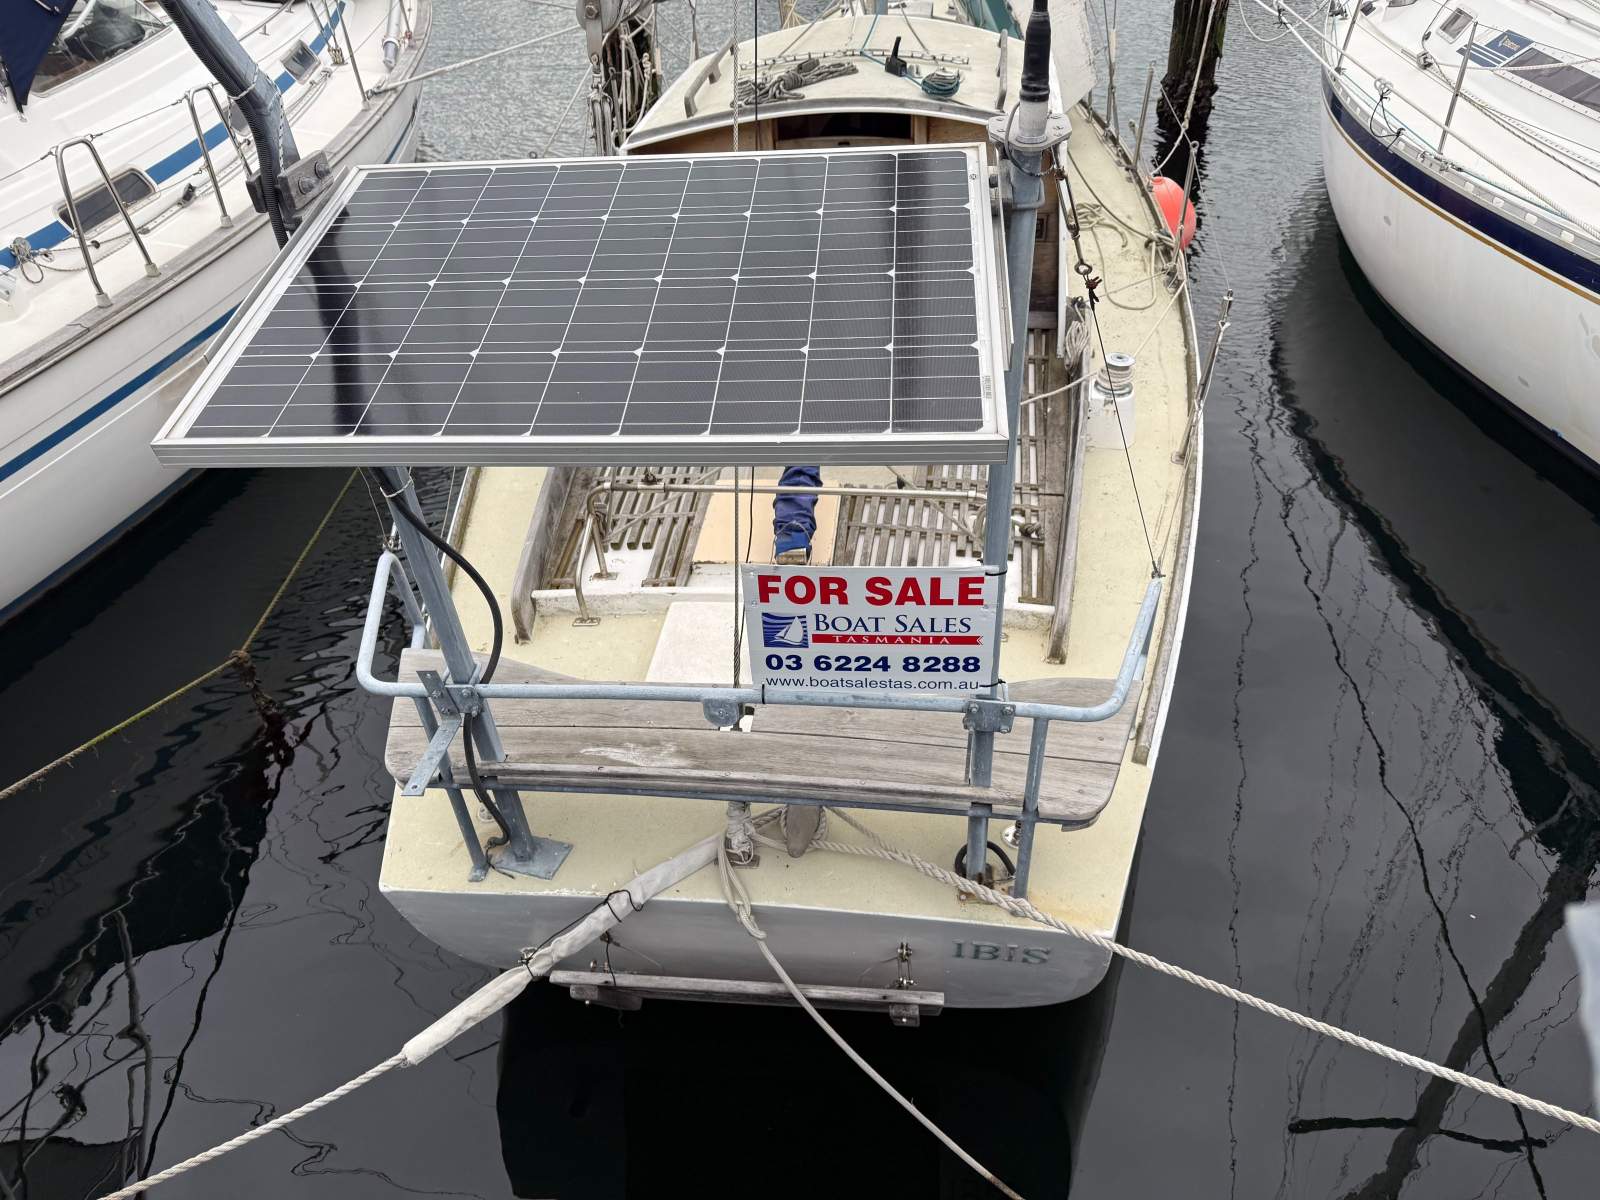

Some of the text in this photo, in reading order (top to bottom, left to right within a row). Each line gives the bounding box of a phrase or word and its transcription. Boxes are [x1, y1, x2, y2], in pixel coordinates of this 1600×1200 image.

[757, 574, 985, 606] FOR SALE
[814, 613, 972, 633] BOAT SALES
[832, 636, 951, 645] TASMANIA
[765, 653, 981, 673] 03 6224 8288
[766, 676, 980, 691] www.boatsalestas.com.au
[952, 940, 1051, 965] IBIS
